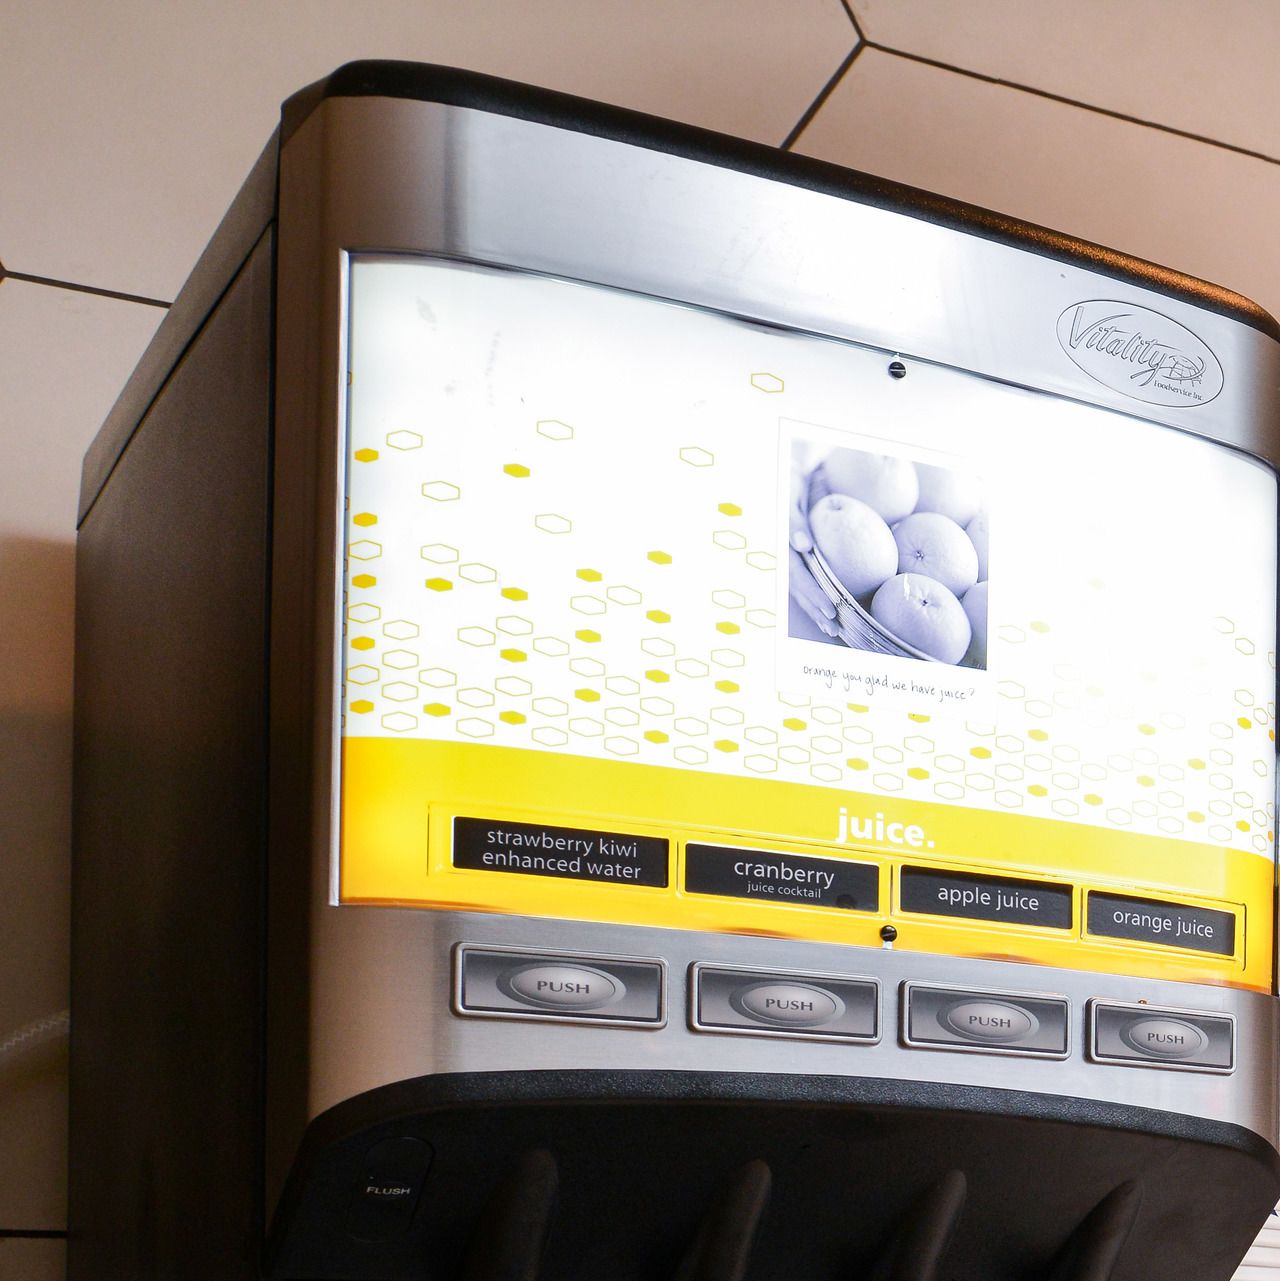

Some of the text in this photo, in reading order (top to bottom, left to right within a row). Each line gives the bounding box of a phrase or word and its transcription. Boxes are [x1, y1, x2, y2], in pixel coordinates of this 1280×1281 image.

[1069, 306, 1178, 386] Vitality
[803, 664, 975, 703] orange you glad we have juice?
[835, 806, 936, 849] juice.
[486, 828, 638, 859] strawberry kiwi
[481, 848, 642, 880] enhanced water
[733, 858, 836, 890] cranberry
[746, 879, 822, 900] juice cocktail
[937, 886, 1040, 912] apple juice
[1112, 908, 1214, 938] orange juice
[536, 979, 591, 995] PUSH
[765, 997, 814, 1012] PUSH
[968, 1015, 1012, 1029] PUSH
[1146, 1031, 1185, 1046] PUSH
[366, 1186, 411, 1195] FLUSH
